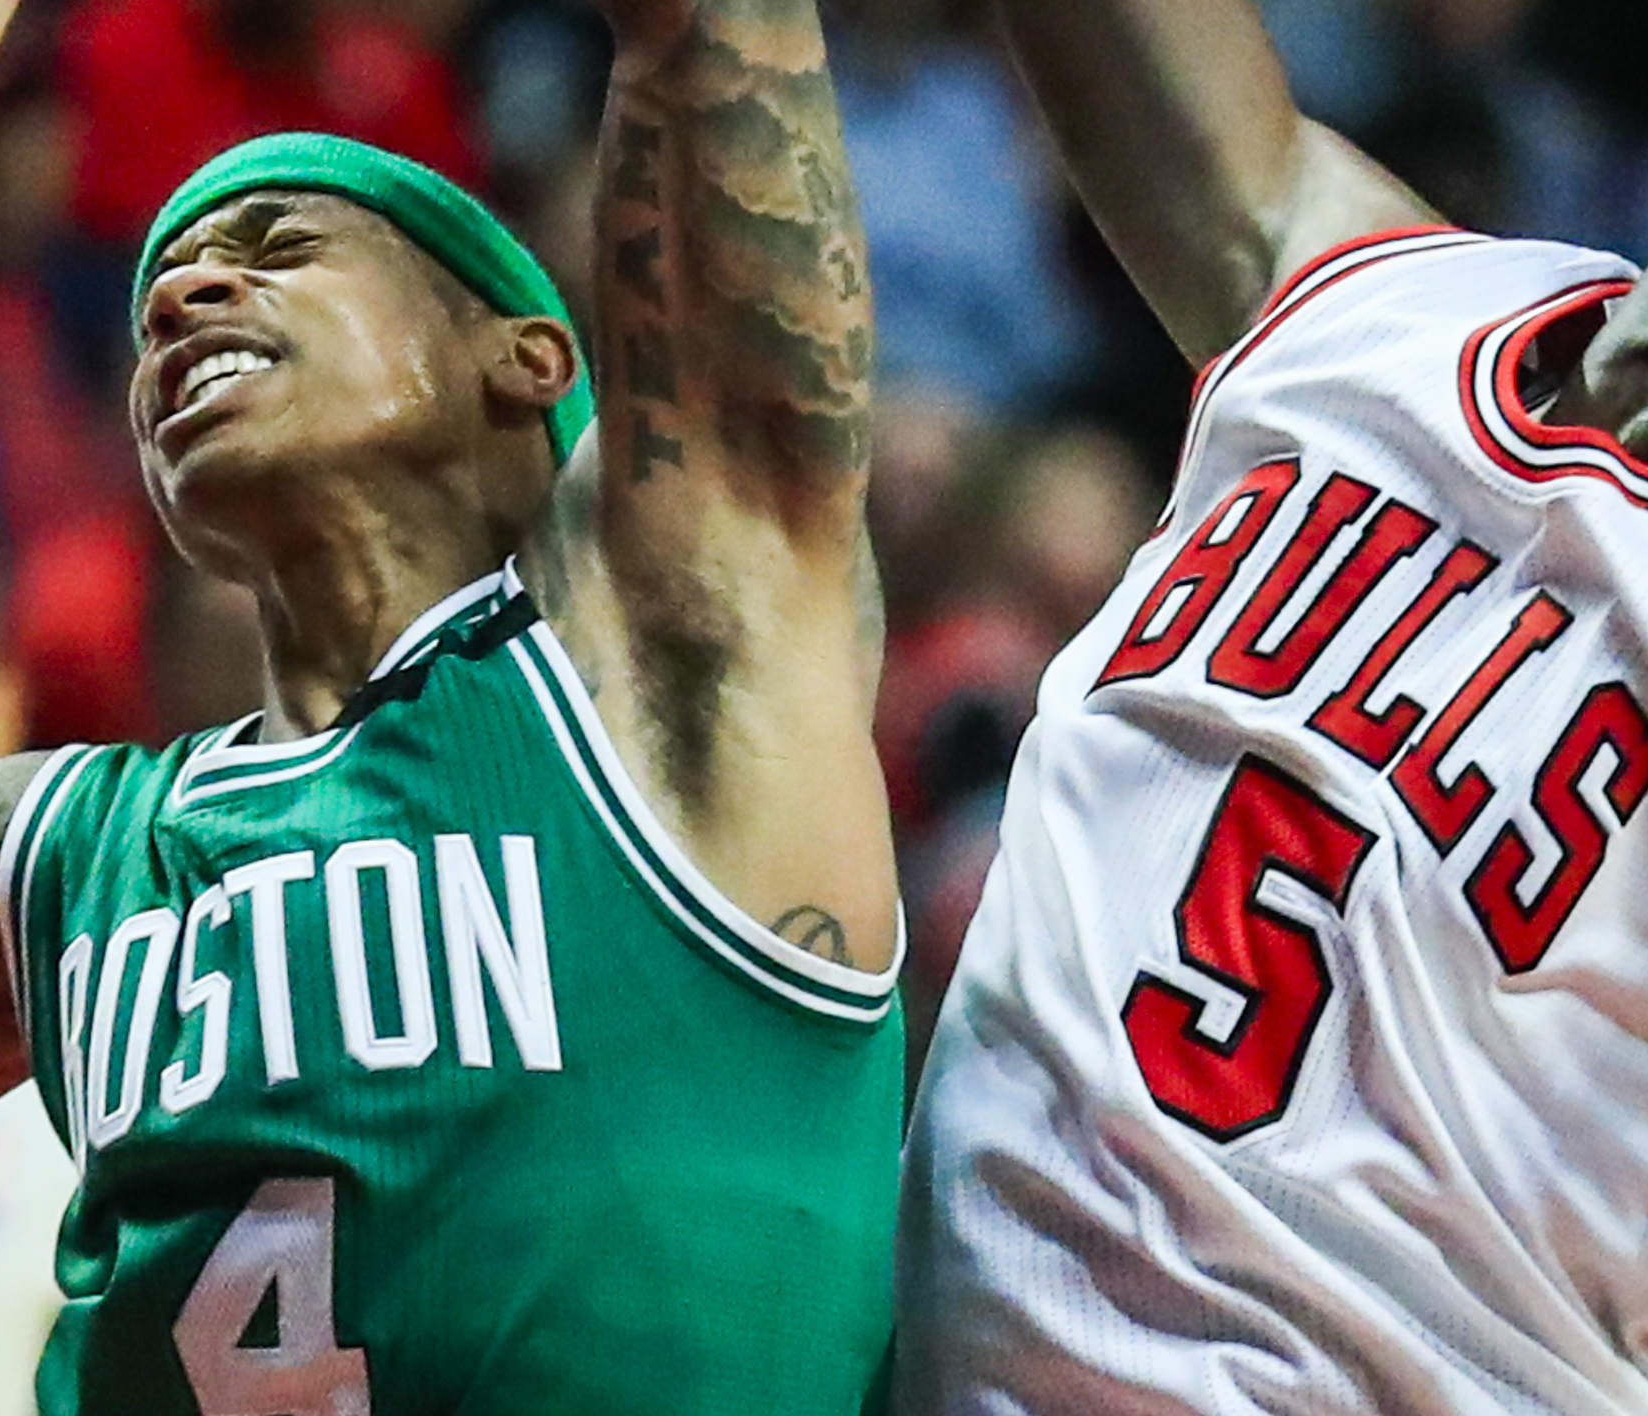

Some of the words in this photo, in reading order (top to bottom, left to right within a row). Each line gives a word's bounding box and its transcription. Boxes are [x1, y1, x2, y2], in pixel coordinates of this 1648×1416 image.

[59, 833, 562, 1181] BOSTON
[1120, 752, 1379, 1144] 5
[173, 1176, 373, 1416] 4
